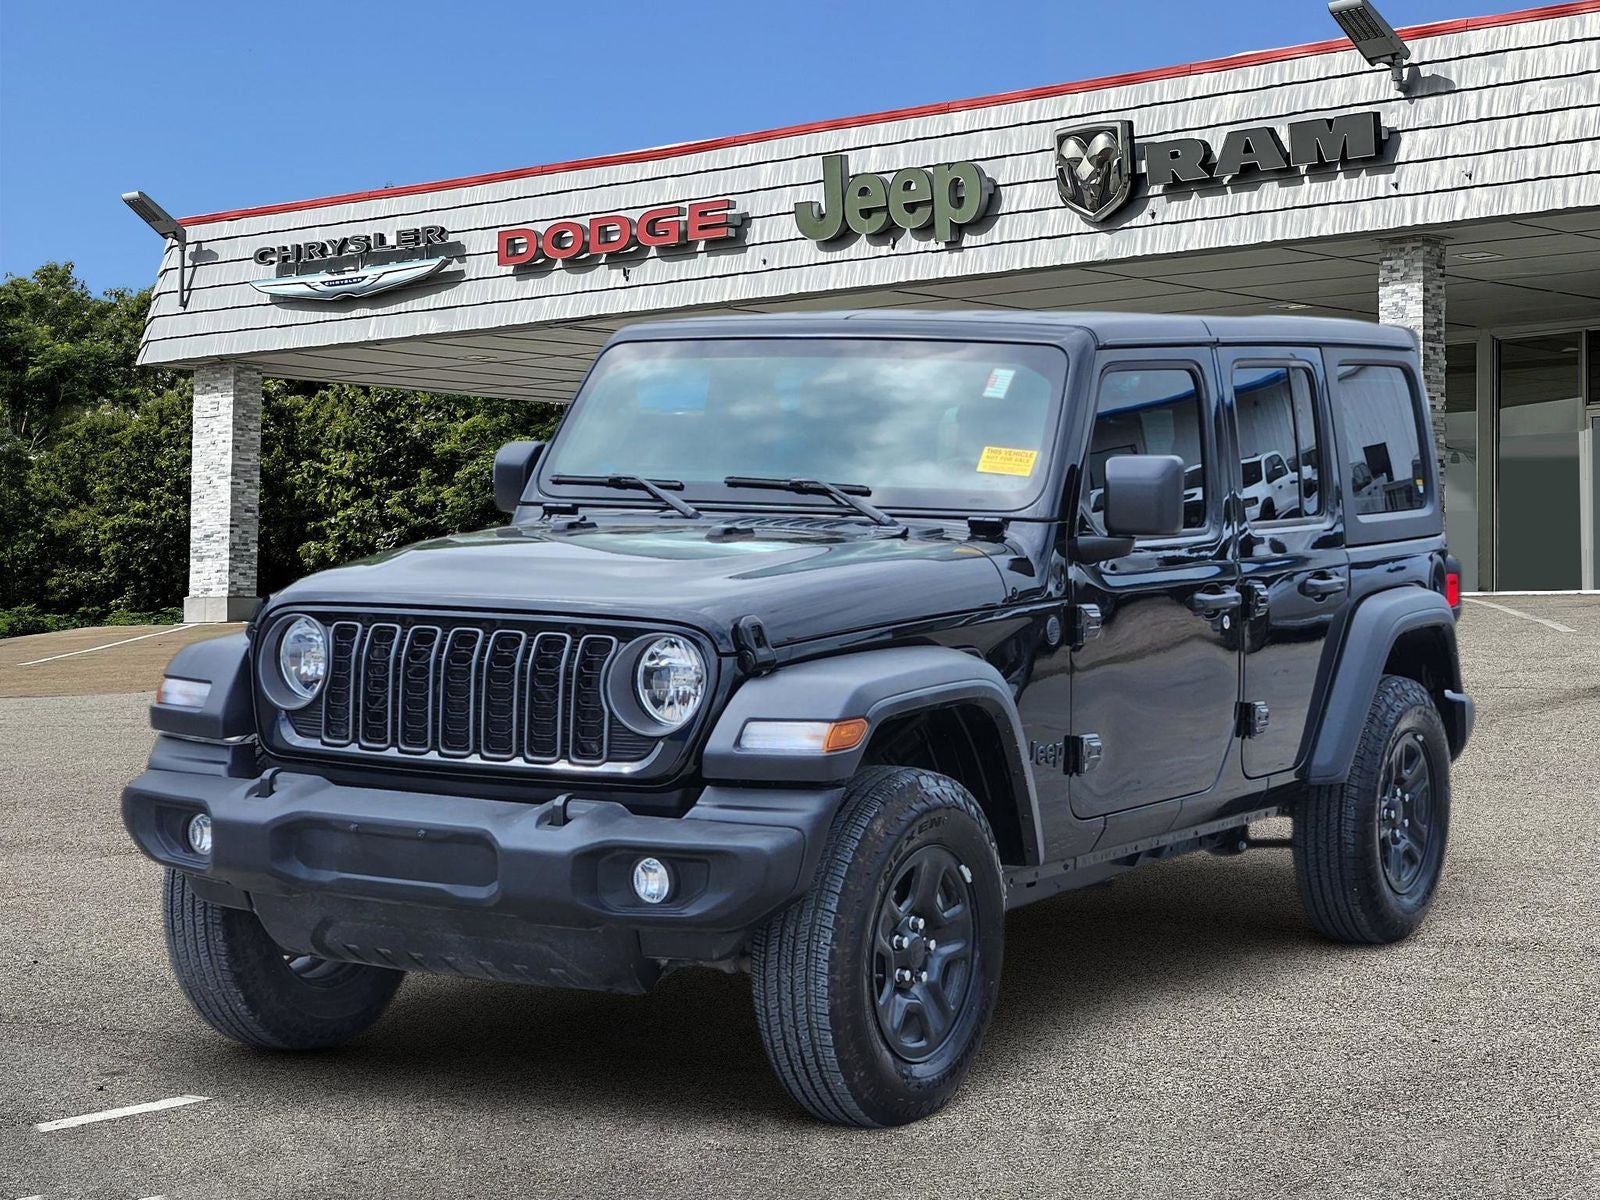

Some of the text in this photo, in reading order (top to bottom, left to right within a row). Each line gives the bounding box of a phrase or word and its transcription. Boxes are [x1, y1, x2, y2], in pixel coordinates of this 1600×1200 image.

[1144, 111, 1382, 186] RAM
[794, 154, 985, 242] Jeep
[253, 225, 450, 266] CHRYSLER
[498, 199, 736, 266] DODGE
[325, 278, 362, 286] CHRYSLER
[1004, 450, 1035, 459] VEHICLE
